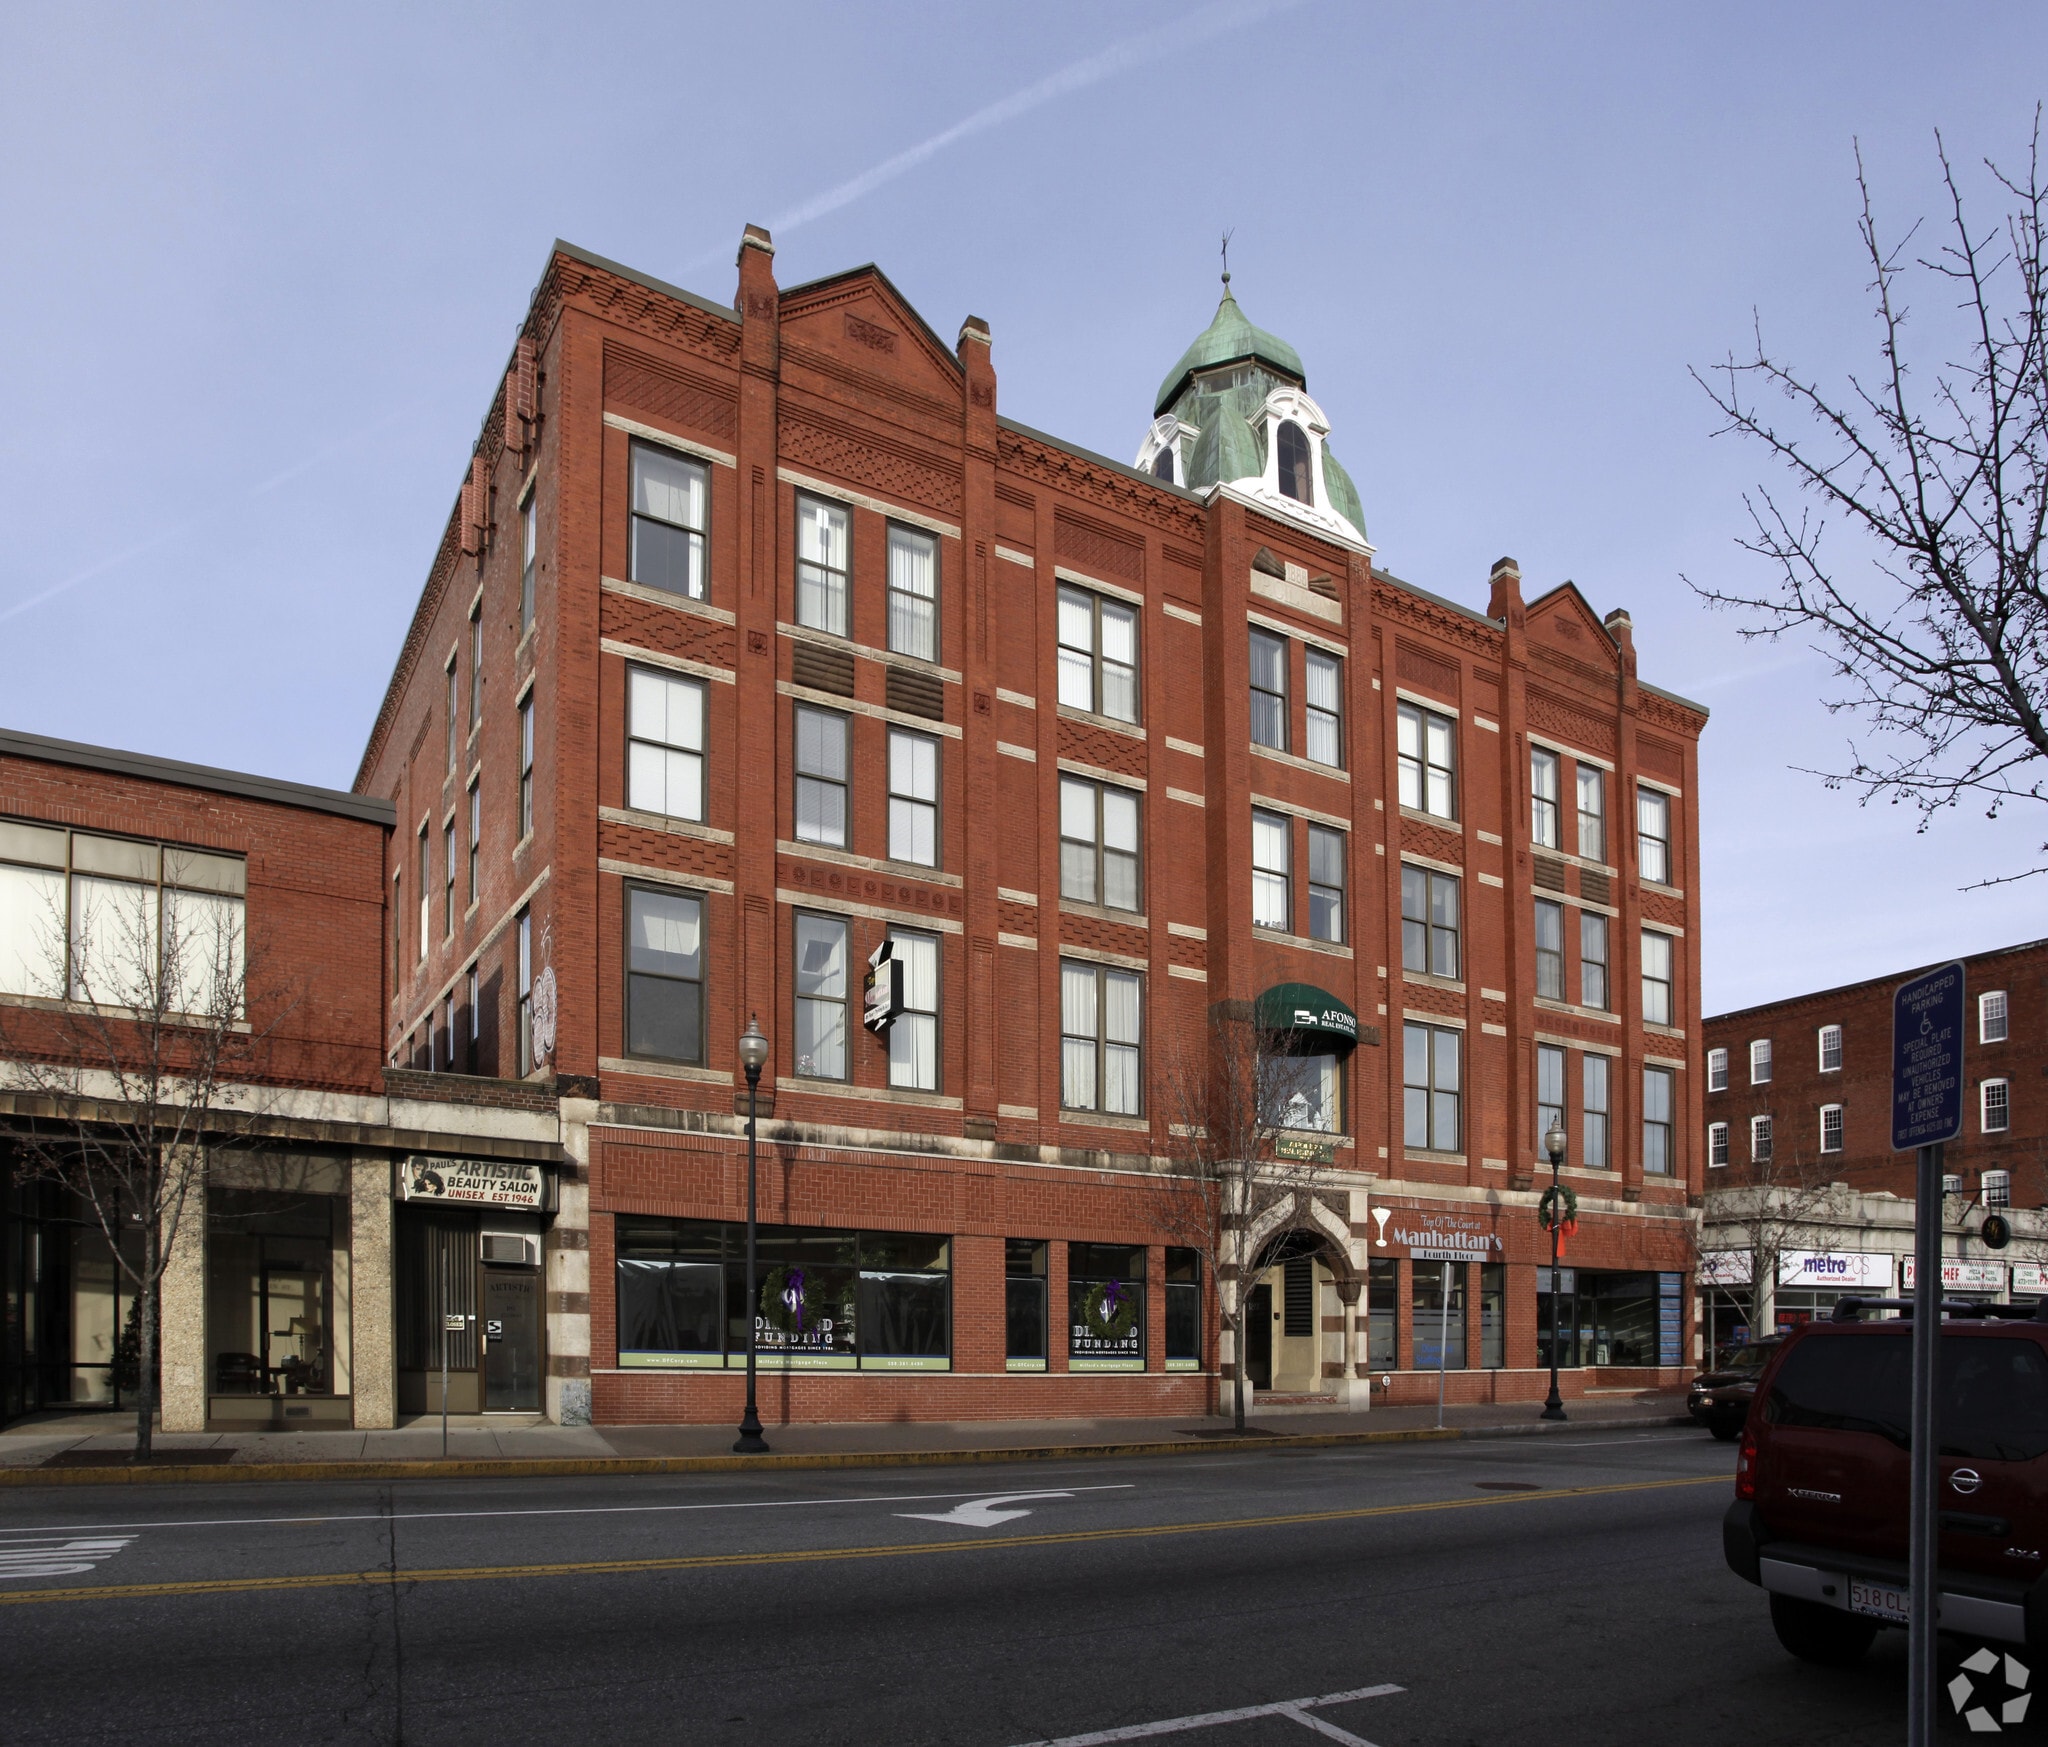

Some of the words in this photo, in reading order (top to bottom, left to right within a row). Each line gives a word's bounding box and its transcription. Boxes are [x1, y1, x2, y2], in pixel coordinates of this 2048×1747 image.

[1901, 974, 1955, 1006] HANDICAPPED
[1911, 992, 1943, 1014] PARKING
[1321, 1009, 1356, 1028] AFONSO
[1903, 1036, 1928, 1054] SPECIAL
[1931, 1026, 1952, 1043] PLATE
[1911, 1043, 1942, 1063] REQUIRED
[1902, 1053, 1951, 1078] UNAUTHORIZED
[1911, 1068, 1942, 1087] VEHICLES
[1898, 1090, 1910, 1104] MAY
[1912, 1086, 1922, 1099] BE
[1924, 1076, 1955, 1096] REMOVED
[1907, 1101, 1915, 1112] AT
[1917, 1092, 1944, 1110] OWNERS
[1910, 1106, 1940, 1124] EXPENSE
[430, 1159, 457, 1170] PAUL'S
[456, 1161, 533, 1180] ARTISTIC
[447, 1176, 497, 1190] BEAUTY
[499, 1181, 537, 1193] SALON
[448, 1189, 485, 1200] UNISEX
[492, 1193, 510, 1202] EST.
[511, 1194, 534, 1203] 1946
[1421, 1215, 1434, 1230] Top
[1435, 1216, 1444, 1230] Of
[1445, 1217, 1457, 1228] The
[1458, 1218, 1474, 1229] Court
[1392, 1227, 1503, 1251] Manhattan's
[1424, 1250, 1451, 1259] Fourth
[1454, 1252, 1473, 1260] Floor
[1804, 1255, 1870, 1275] metroPCS
[1074, 1339, 1138, 1348] FUNDING
[1852, 1585, 1882, 1607] 518
[1886, 1592, 1911, 1613] CL
